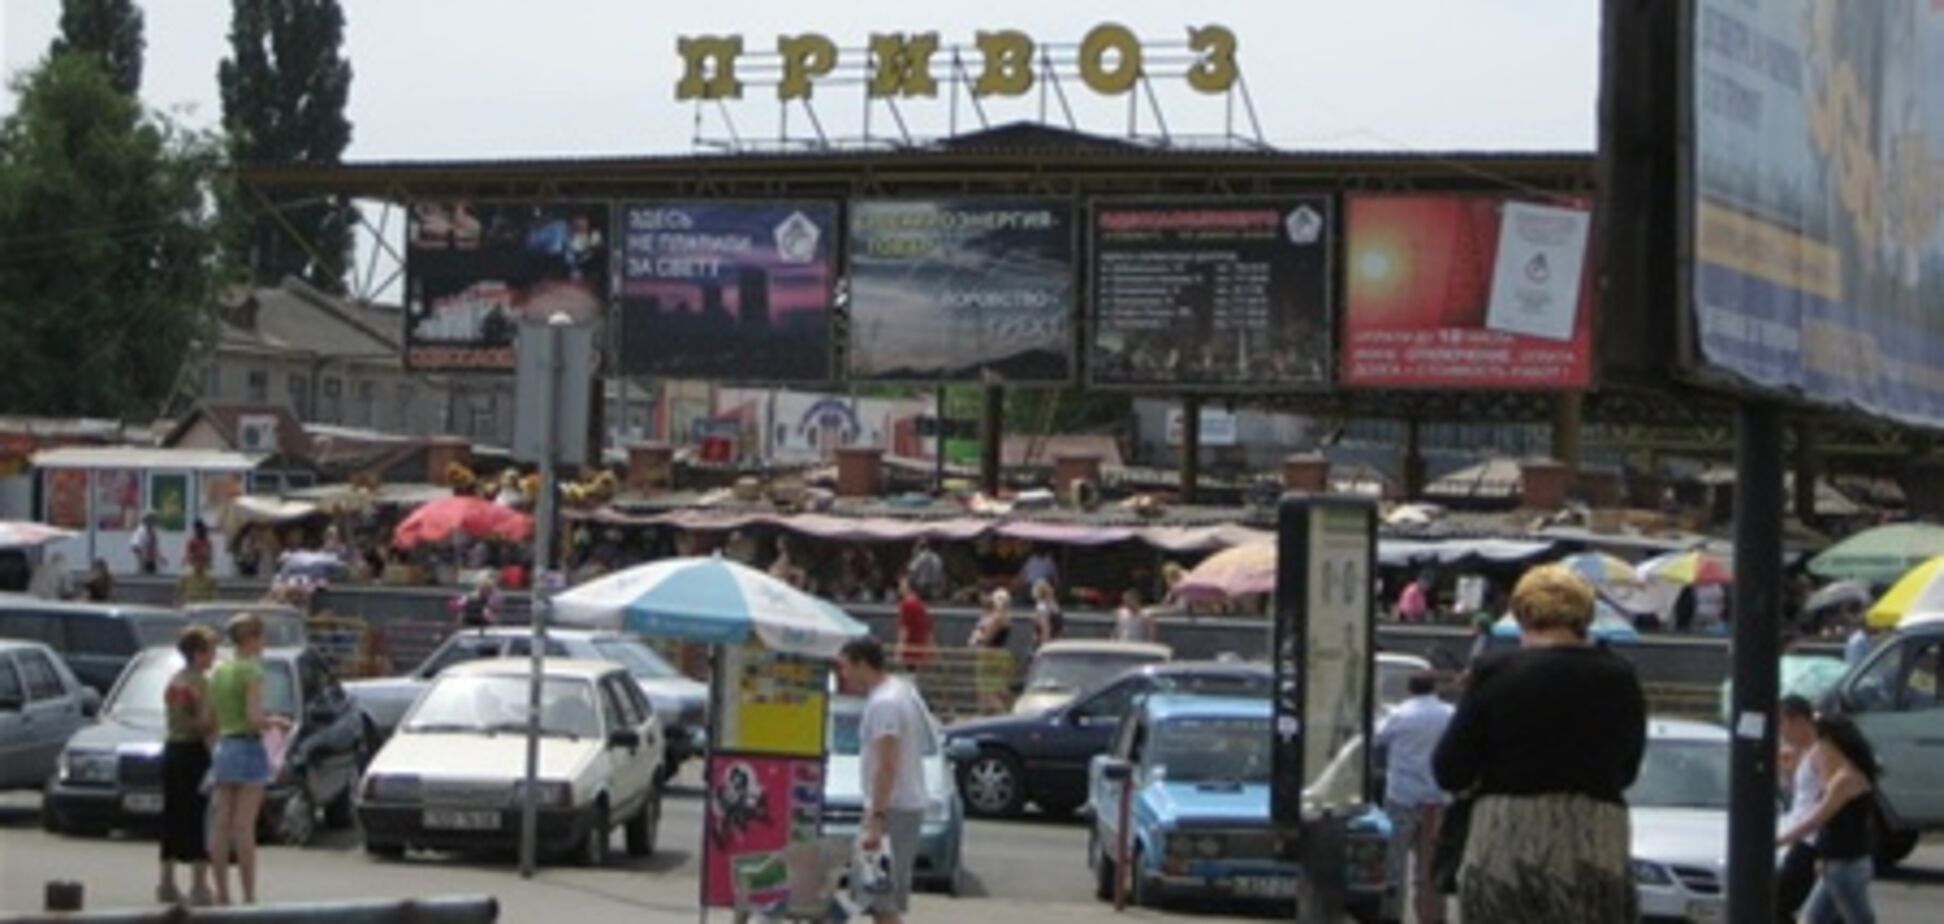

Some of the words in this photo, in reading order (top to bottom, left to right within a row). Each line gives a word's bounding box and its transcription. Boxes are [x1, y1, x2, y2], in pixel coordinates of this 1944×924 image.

[675, 22, 1238, 100] ПРИВОЗ
[629, 209, 694, 229] ЗДЕСЬ
[627, 233, 653, 251] НЕ
[627, 257, 652, 277] ЗА
